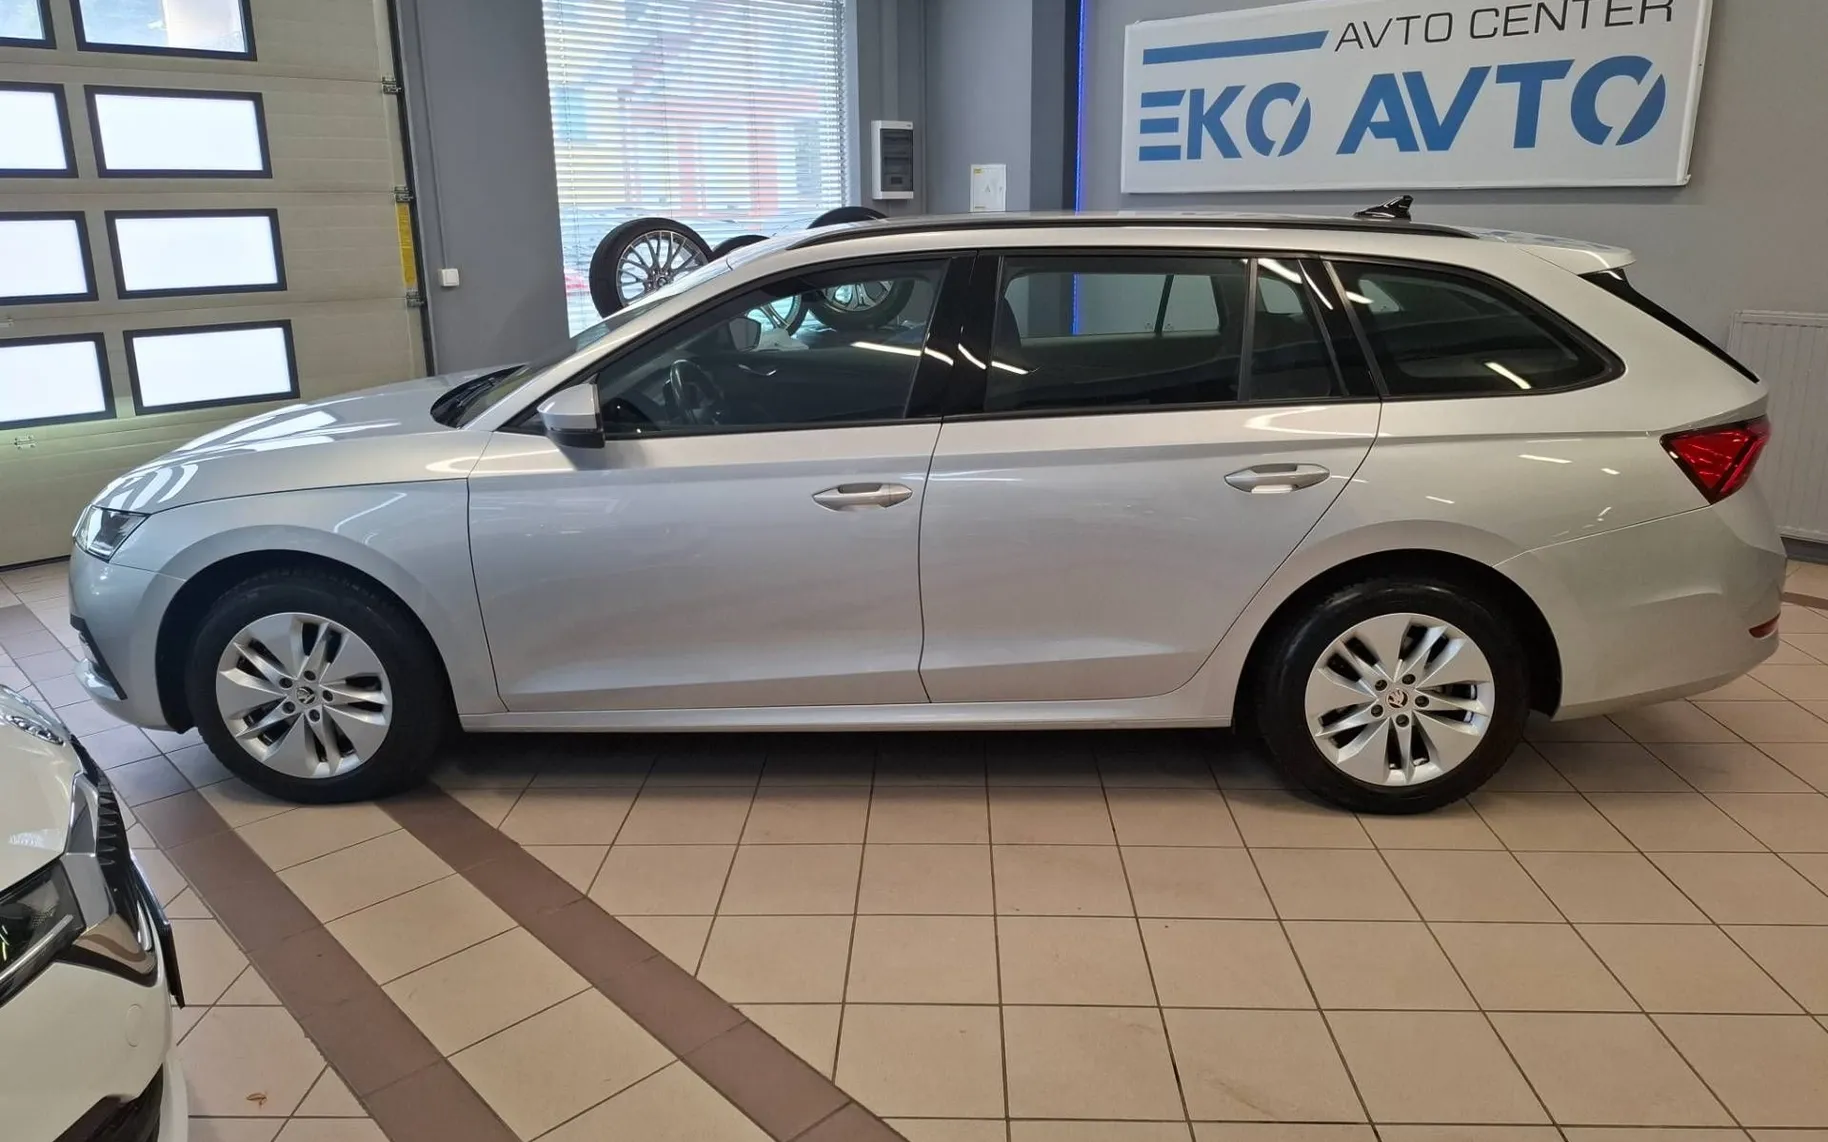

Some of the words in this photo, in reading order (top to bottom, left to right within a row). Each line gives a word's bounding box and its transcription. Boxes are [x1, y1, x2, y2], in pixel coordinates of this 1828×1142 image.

[1335, 12, 1452, 52] AVTO
[1470, 0, 1674, 40] CENTER
[1138, 82, 1311, 163] EKO
[1337, 56, 1666, 155] AVTO
